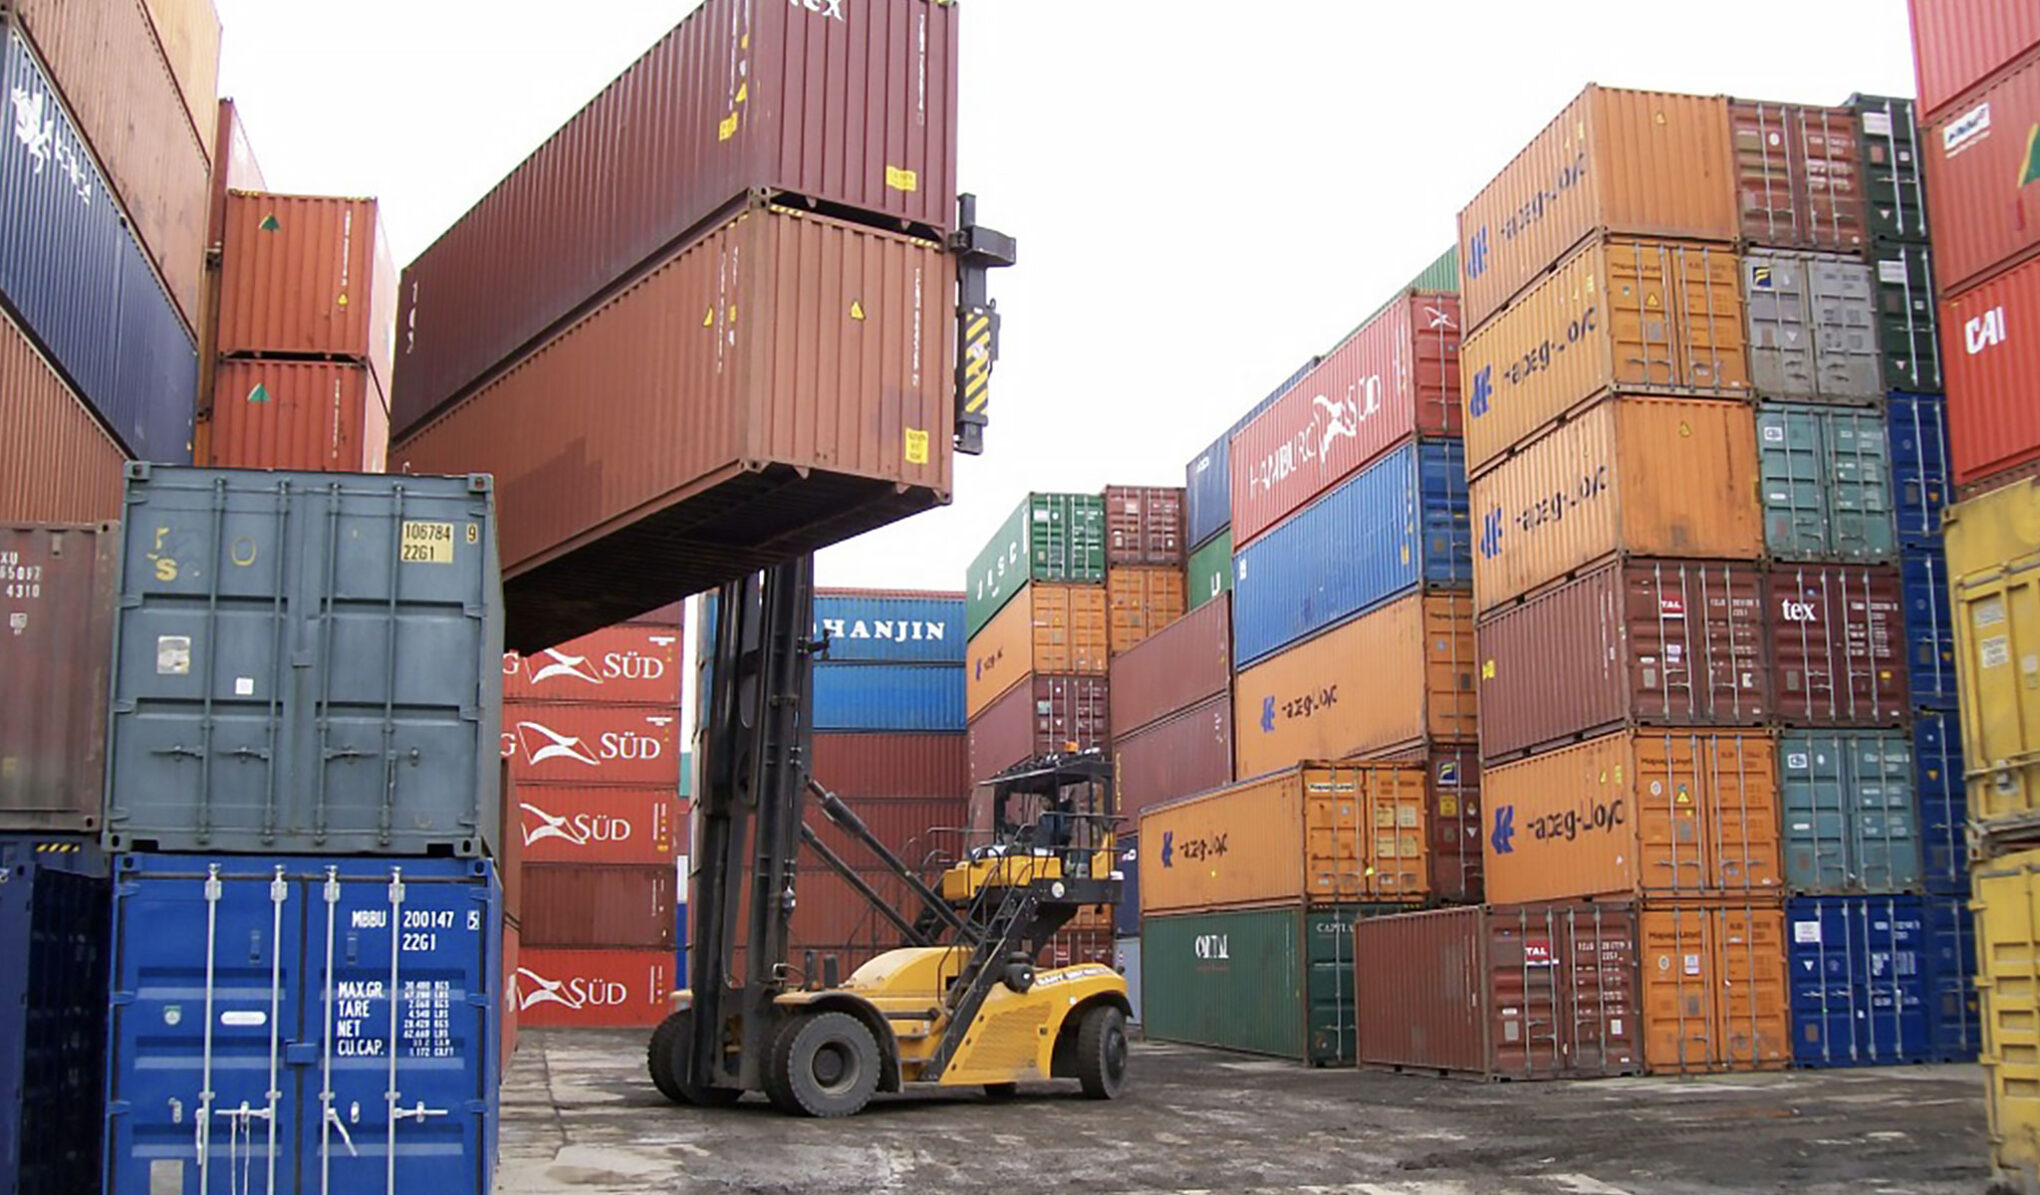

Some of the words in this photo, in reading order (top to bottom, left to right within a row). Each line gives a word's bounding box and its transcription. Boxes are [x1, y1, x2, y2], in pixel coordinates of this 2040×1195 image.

[787, 0, 847, 22] ex
[1965, 306, 2006, 354] CAI
[405, 523, 451, 542] 106784
[468, 525, 477, 542] 9
[403, 544, 434, 561] 22G1
[6, 583, 40, 599] 4310
[1781, 598, 1816, 621] tex
[822, 618, 946, 642] HANJIN
[602, 651, 664, 679] SÜD
[599, 731, 661, 760] SÜD
[573, 812, 632, 842] SÜD
[351, 910, 387, 928] MBBU
[403, 910, 454, 928] 200147
[402, 933, 437, 951] 22G1
[1524, 946, 1548, 956] TAL
[569, 976, 628, 1005] SÜD
[338, 999, 371, 1018] TARE
[336, 1019, 362, 1037] NET
